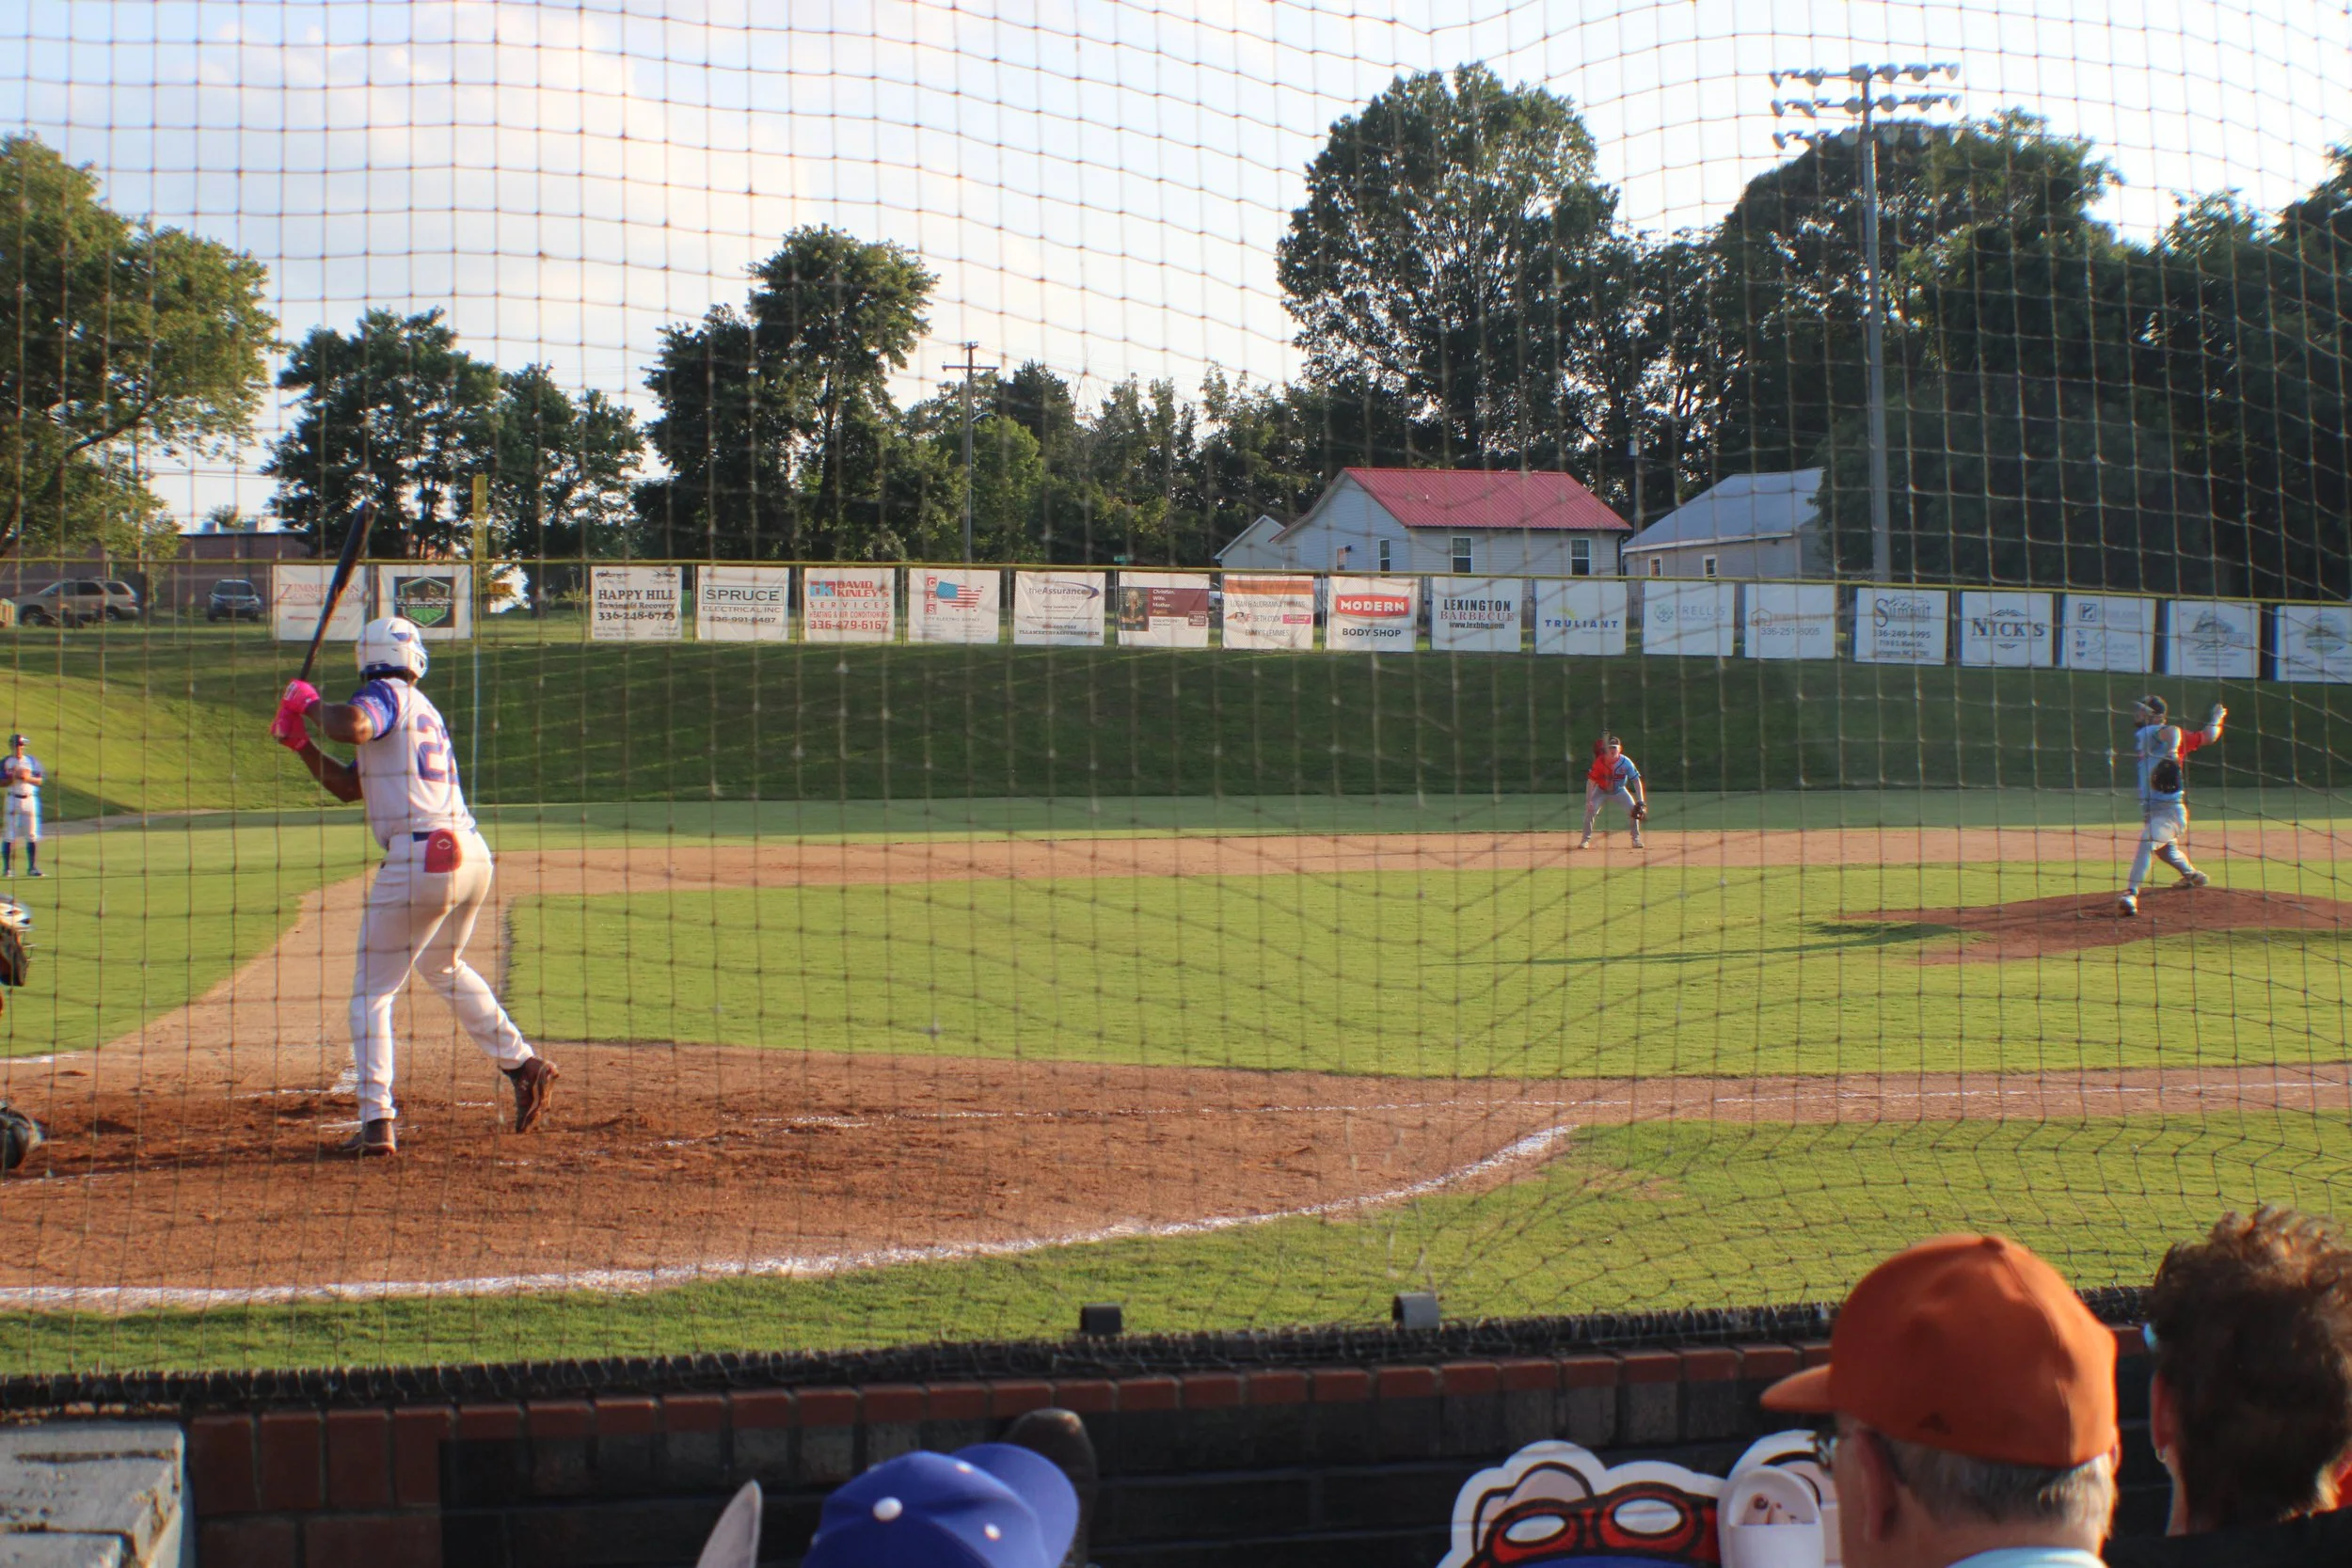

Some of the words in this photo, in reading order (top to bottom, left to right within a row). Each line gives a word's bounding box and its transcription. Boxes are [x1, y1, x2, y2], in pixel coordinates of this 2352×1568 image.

[836, 580, 873, 589] DAVID
[598, 590, 643, 600] HAPPY
[646, 590, 675, 600] HILL
[706, 589, 780, 602] SPRUCE
[598, 602, 628, 610] Towing
[639, 602, 675, 610] Recovery
[1340, 600, 1405, 611] MODERN
[1444, 599, 1511, 611] LEXINGTON
[1440, 610, 1515, 622] BARBECUE
[1545, 619, 1618, 628] TRULIANT
[1971, 617, 2045, 637] NICKS
[1342, 628, 1371, 637] BODY
[1373, 628, 1401, 637] SHOP
[417, 713, 460, 784] 2
